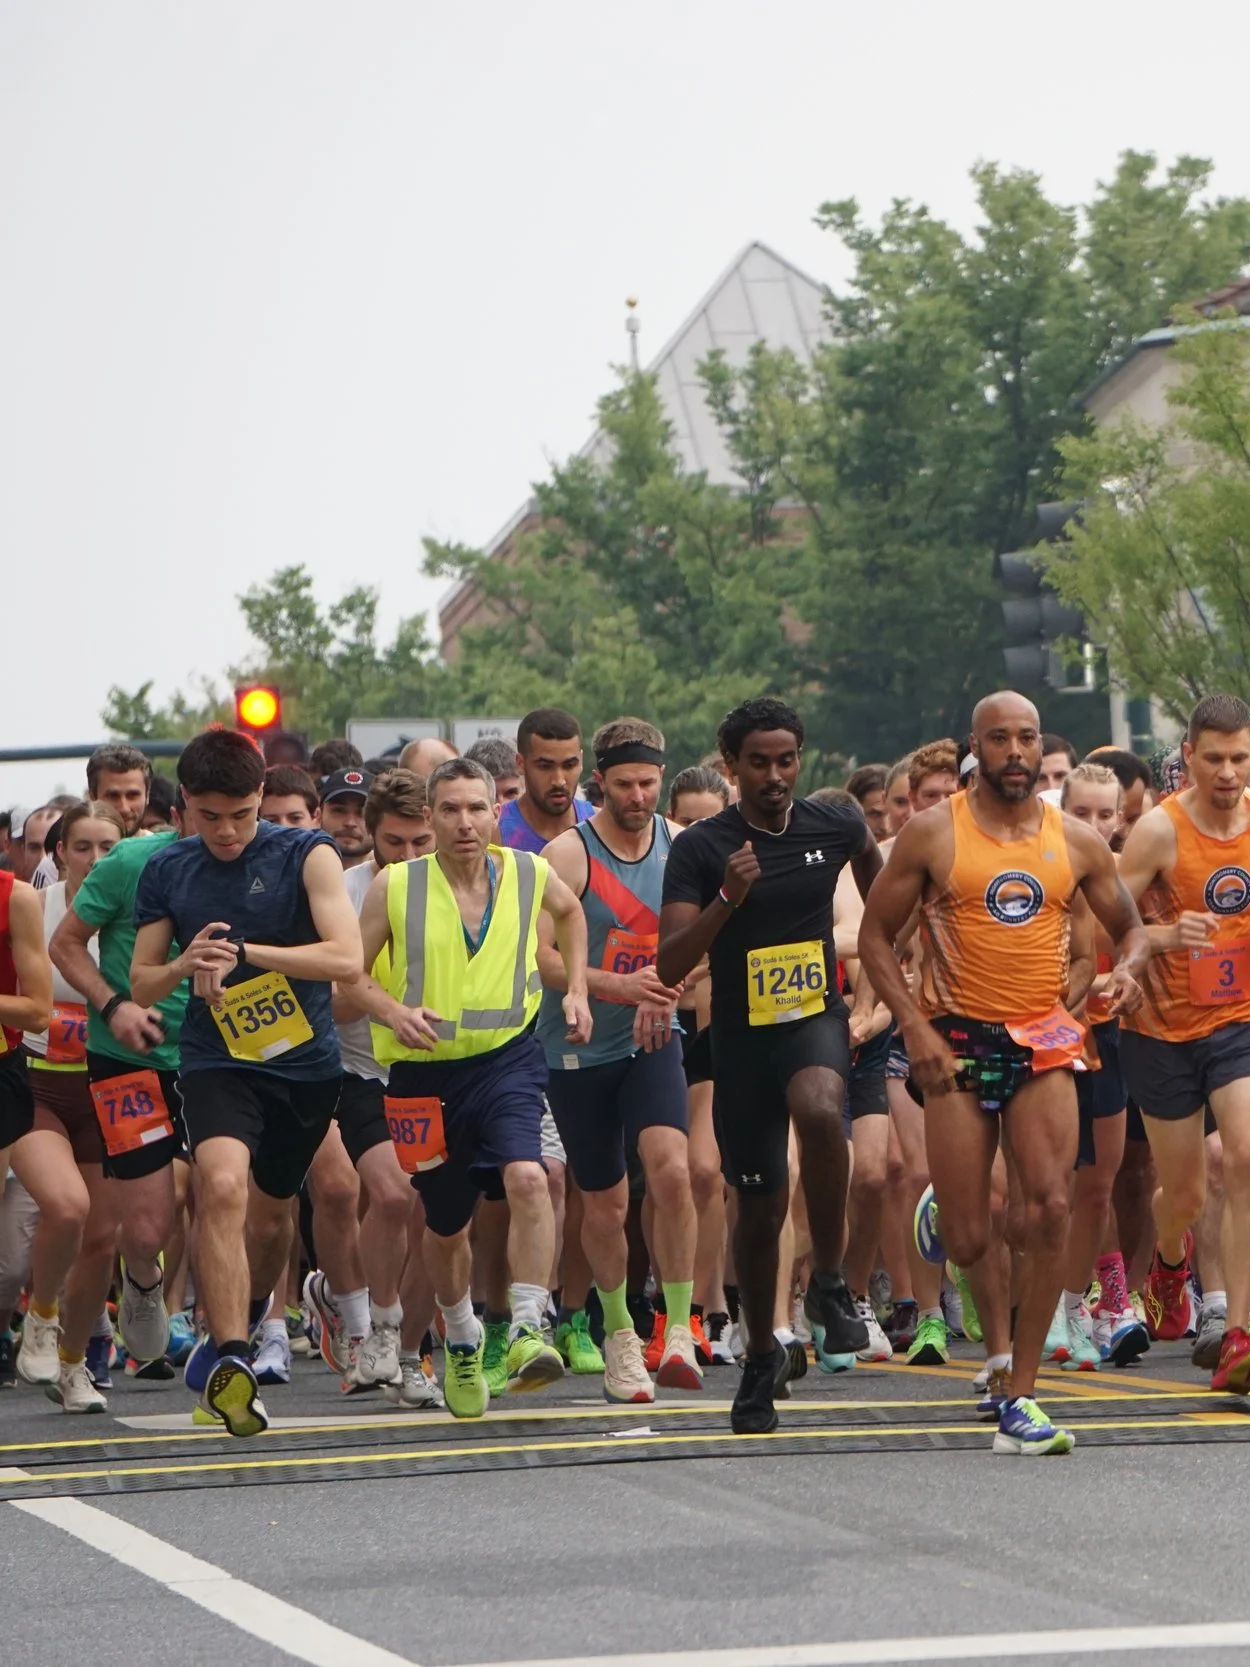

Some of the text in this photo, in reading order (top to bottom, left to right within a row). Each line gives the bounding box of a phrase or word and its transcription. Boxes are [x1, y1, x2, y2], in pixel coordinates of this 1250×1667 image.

[614, 951, 657, 974] 60
[1219, 959, 1235, 987] 3
[752, 961, 823, 996] 1246
[775, 995, 802, 1006] Khalid
[220, 990, 297, 1040] 1356
[103, 1090, 155, 1126] 748
[388, 1117, 431, 1145] 987
